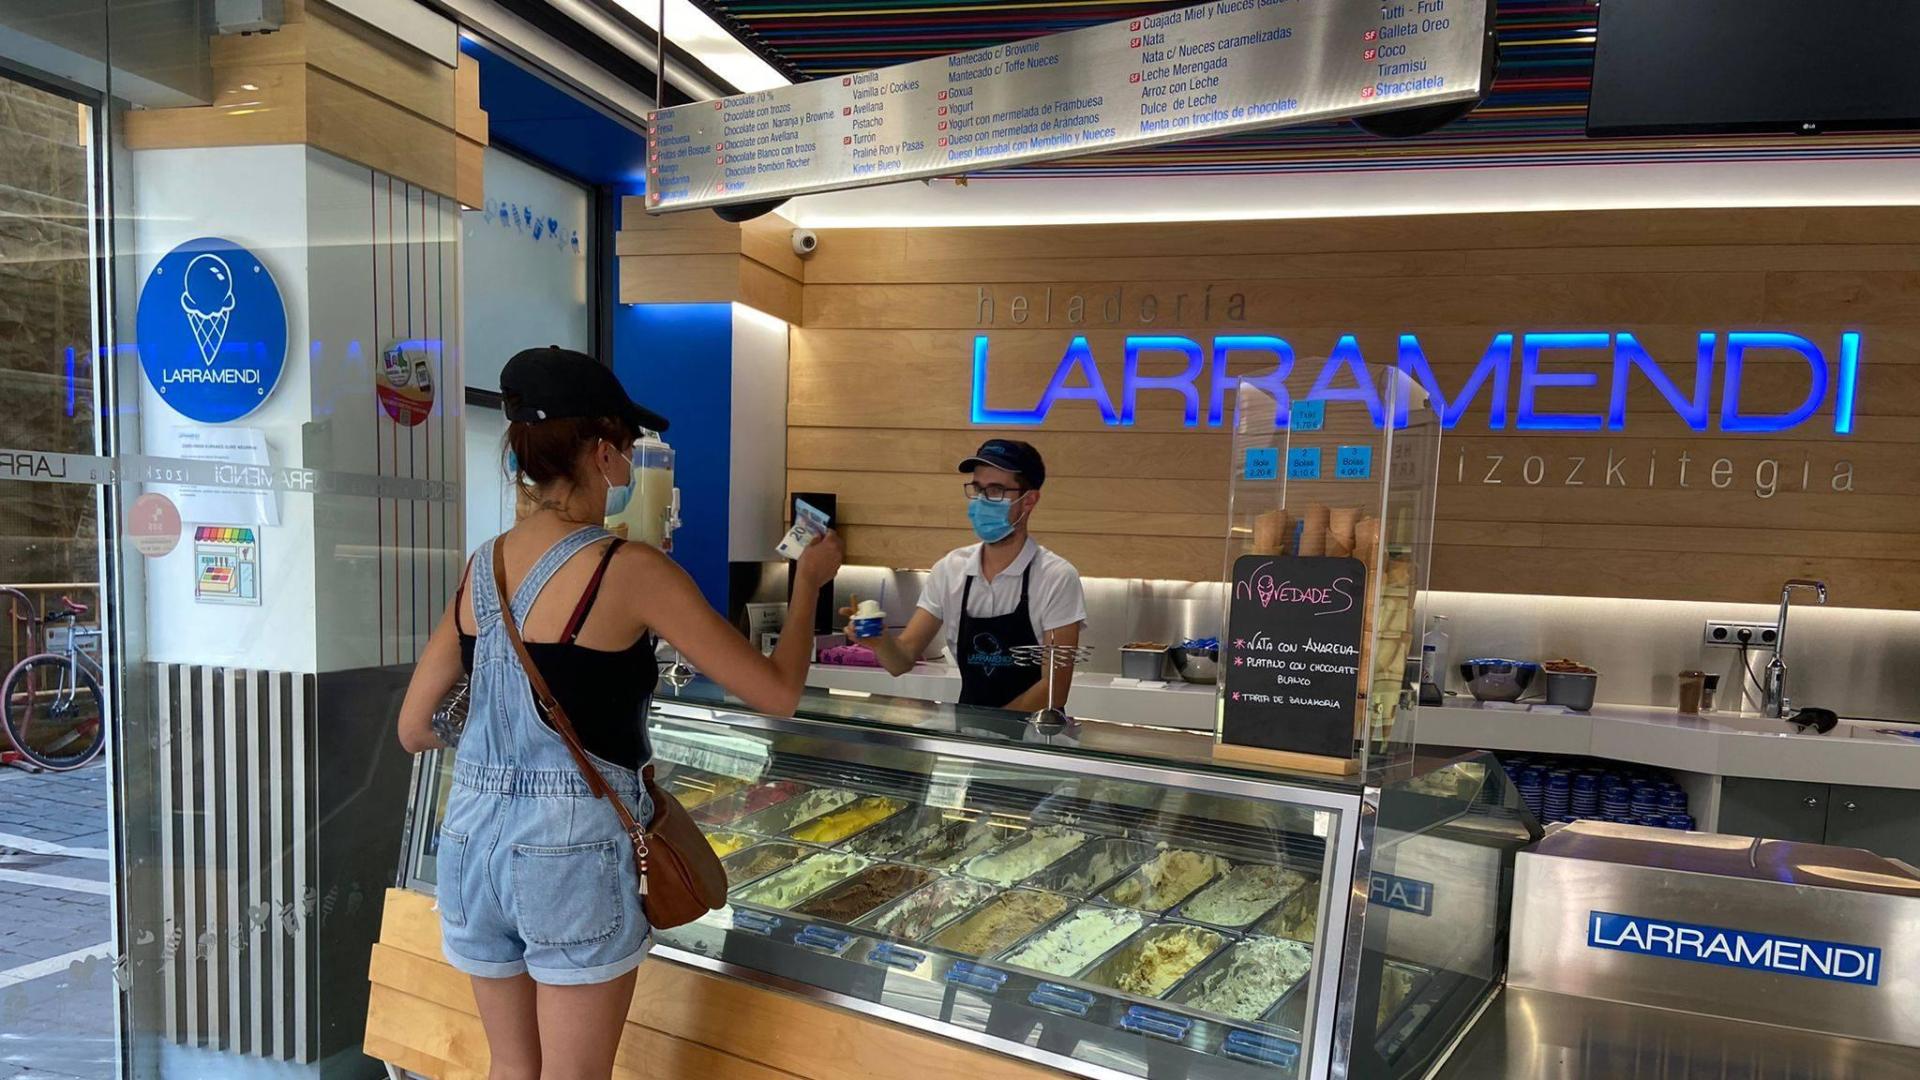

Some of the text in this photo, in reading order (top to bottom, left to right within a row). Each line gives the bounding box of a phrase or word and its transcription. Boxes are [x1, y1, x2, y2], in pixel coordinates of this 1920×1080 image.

[1142, 12, 1181, 30] Cuajada
[1184, 8, 1205, 22] Miel
[1208, 8, 1214, 20] y
[1216, 0, 1254, 15] Nueces
[1381, 5, 1404, 20] Tutti
[1417, 0, 1444, 14] Fruti
[1142, 32, 1164, 46] Nata
[1380, 24, 1418, 40] Galleta
[1422, 18, 1450, 32] Oreo
[948, 52, 992, 67] Mantecado
[1006, 42, 1040, 56] Brownie
[1142, 50, 1164, 64] Nata
[1179, 42, 1215, 57] Nueces
[1218, 27, 1292, 49] caramelizadas
[1378, 44, 1406, 58] Coco
[948, 66, 992, 82] Mantecado
[1026, 54, 1059, 68] Nueces
[1142, 66, 1170, 82] Leche
[1173, 56, 1228, 75] Merengada
[1378, 56, 1427, 76] Tiramisú
[890, 80, 920, 94] Cookies
[948, 86, 972, 98] Goxua
[1142, 76, 1219, 98] Arroz con Leche
[724, 97, 756, 108] Chocolate
[724, 102, 791, 122] Chocolate con trozos
[853, 102, 884, 115] Avellana
[948, 102, 974, 116] Yogurt
[1141, 94, 1217, 116] Dulce de Leche
[724, 124, 756, 136] Chocolate
[757, 121, 770, 132] con
[772, 116, 799, 128] Naranja
[800, 116, 805, 127] y
[806, 110, 834, 123] Brownie
[853, 116, 884, 130] Pistacho
[948, 117, 974, 131] Yogurt
[976, 112, 990, 125] con
[992, 106, 1040, 122] mermelada
[1041, 102, 1052, 114] de
[1054, 96, 1103, 113] Frambuesa
[1140, 98, 1296, 133] Menta con trocitos de chocolate
[724, 138, 756, 150] Chocolate
[757, 135, 770, 145] con
[770, 130, 799, 142] Avellana
[948, 132, 973, 146] Queso
[974, 128, 990, 141] con
[992, 123, 1038, 138] mermelada
[1040, 118, 1051, 130] de
[725, 152, 756, 164] Chocolate
[758, 146, 780, 160] Blanco
[781, 146, 794, 156] con
[795, 142, 816, 153] trozos
[880, 144, 893, 156] Ron
[894, 144, 900, 156] y
[902, 140, 924, 152] Pasas
[948, 148, 972, 161] Queso
[1012, 140, 1029, 152] con
[1030, 132, 1072, 148] Membrillo
[1075, 132, 1080, 143] y
[1082, 128, 1116, 140] Nueces
[725, 166, 756, 178] Chocolate
[786, 157, 810, 168] Rocher
[853, 158, 901, 174] Kinder Bueno
[978, 285, 1248, 325] heladería
[163, 368, 260, 384] LARRAMENDI
[969, 331, 1861, 436] LARRAMENDI
[1458, 447, 1856, 496] izozkitegia
[790, 526, 806, 542] 20
[1246, 631, 1360, 654] NATA CON AMARENA
[1246, 657, 1359, 674] PLATANO CON CHOCOLATE
[1277, 675, 1310, 686] BLANCO
[1242, 693, 1270, 703] TARTA
[1273, 694, 1284, 704] DE
[1594, 916, 1875, 982] LARRAMENDI
